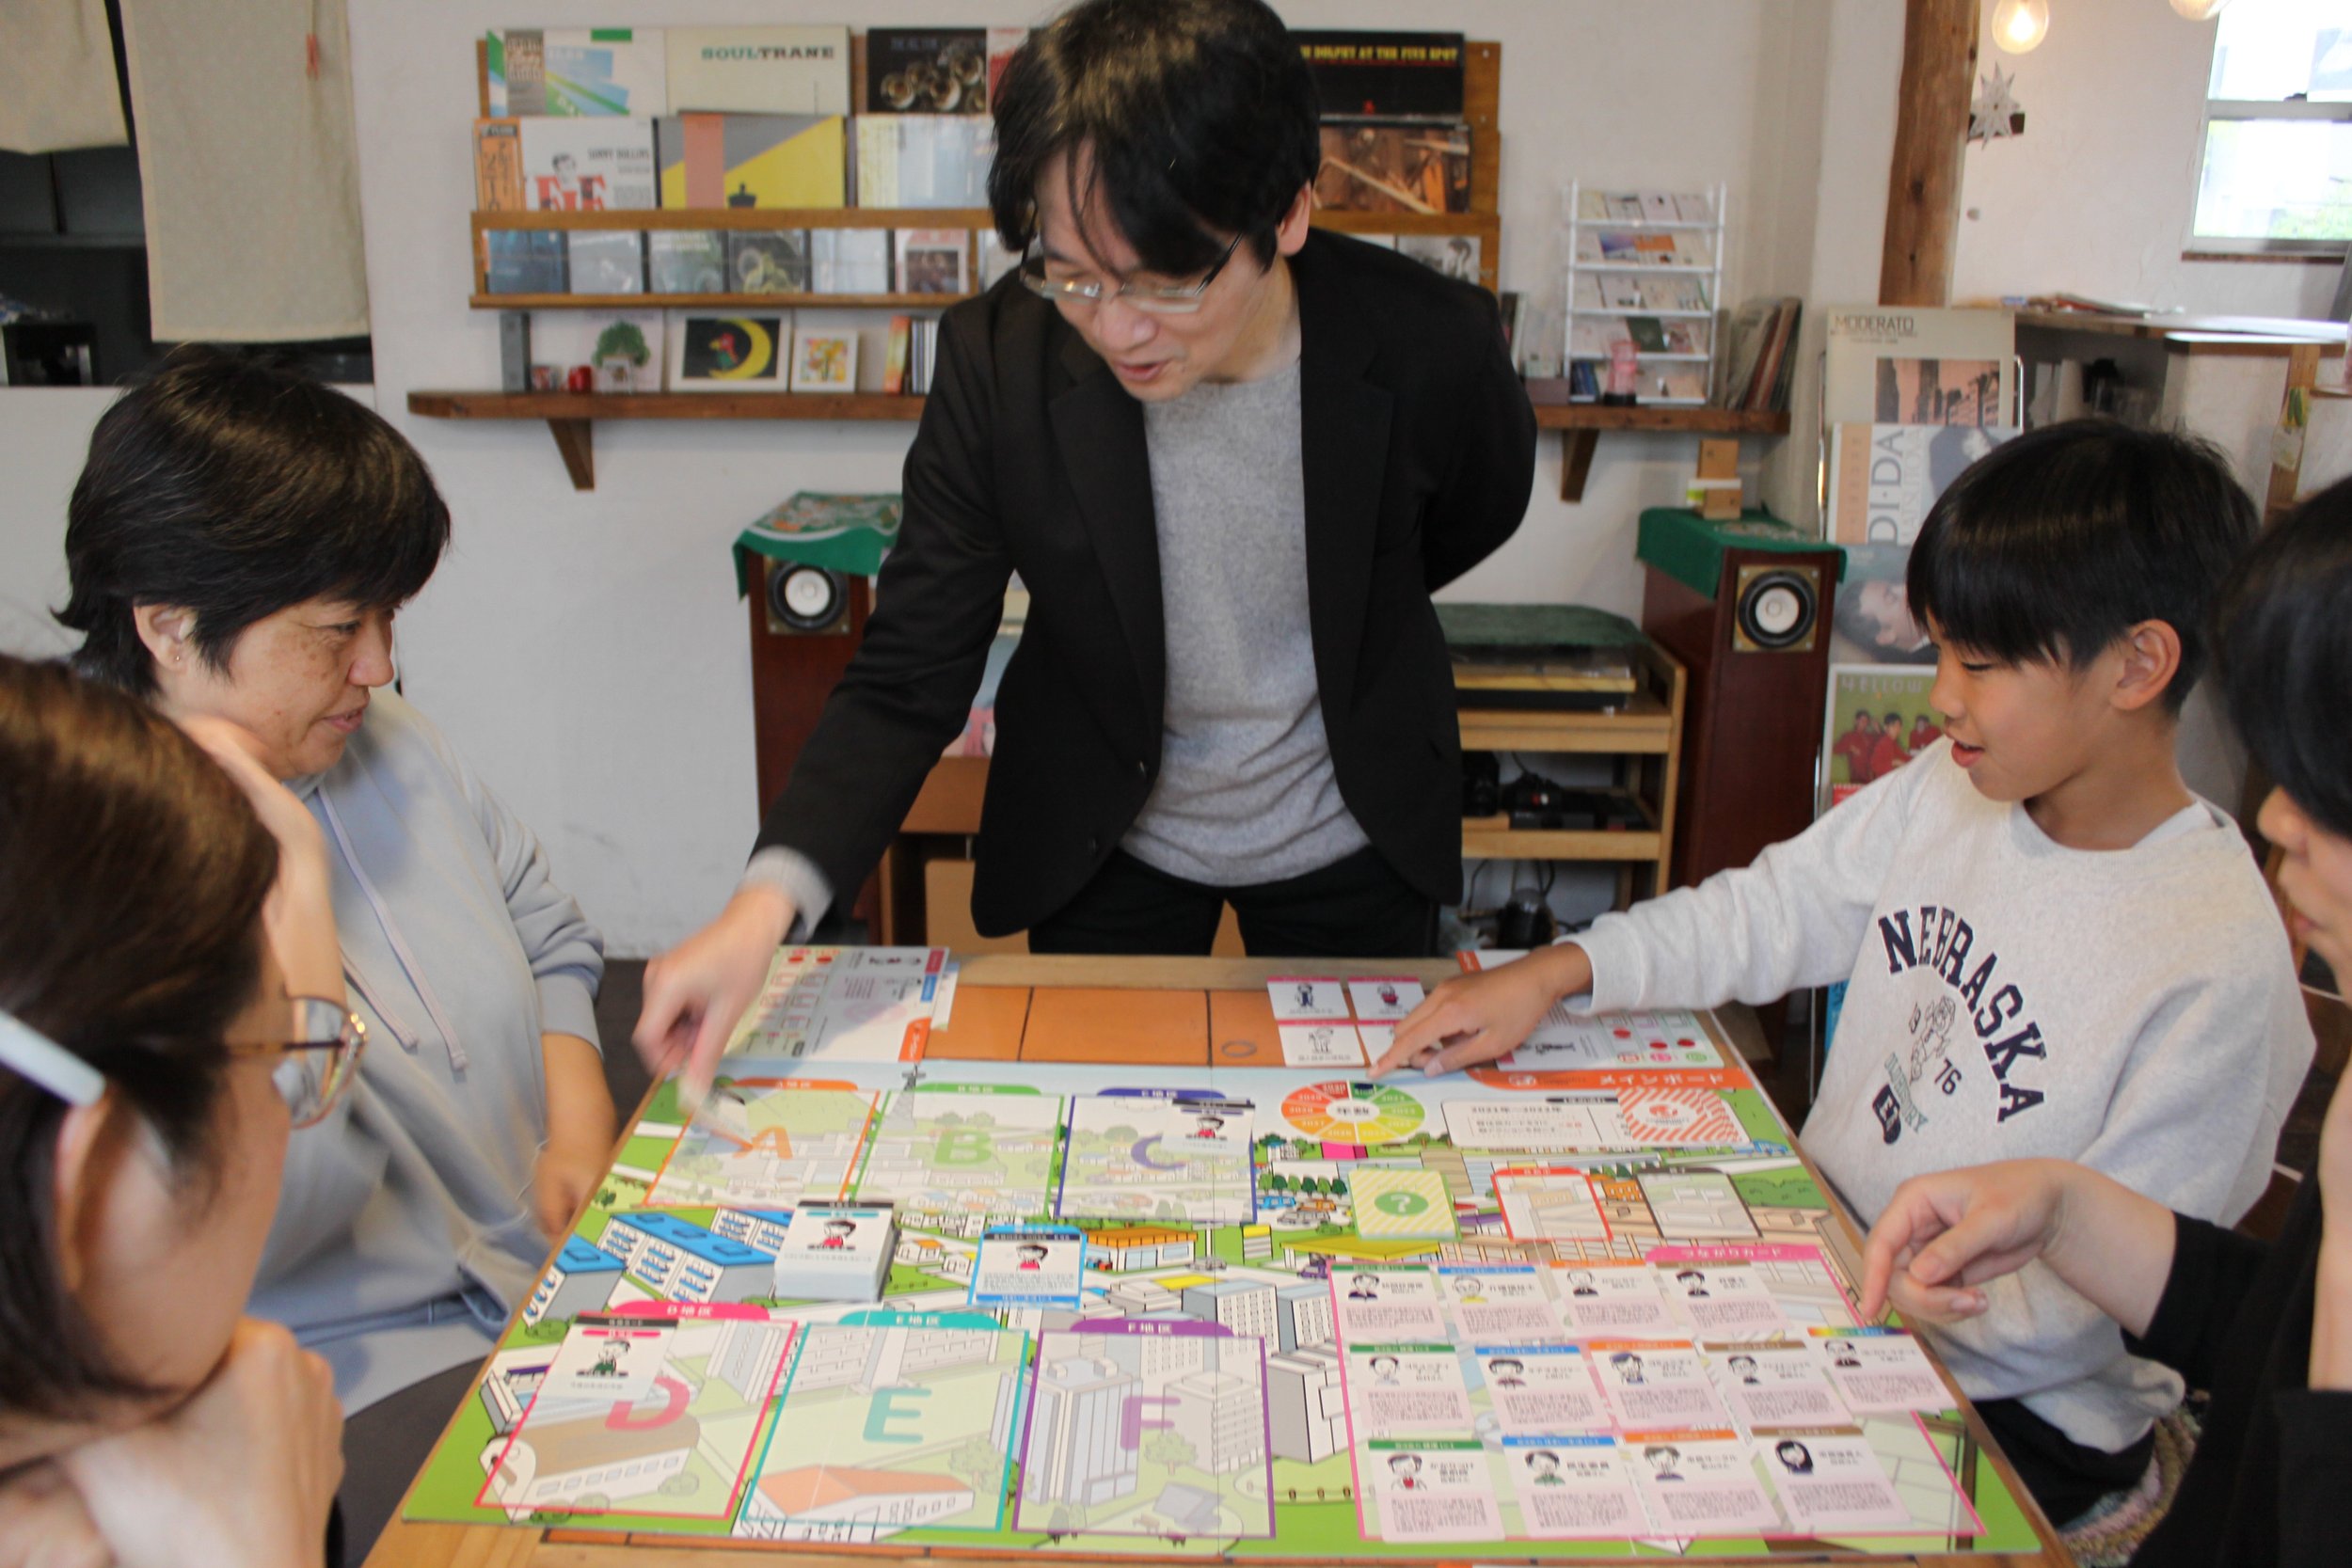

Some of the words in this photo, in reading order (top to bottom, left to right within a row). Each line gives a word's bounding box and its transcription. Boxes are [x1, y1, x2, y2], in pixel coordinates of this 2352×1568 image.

[701, 46, 834, 60] SOULTRANE
[1835, 315, 1914, 332] MODERATO
[1878, 905, 2047, 1124] NEBRASKA
[934, 1131, 993, 1165] B
[862, 1386, 932, 1443] E
[1120, 1395, 1182, 1450] F
